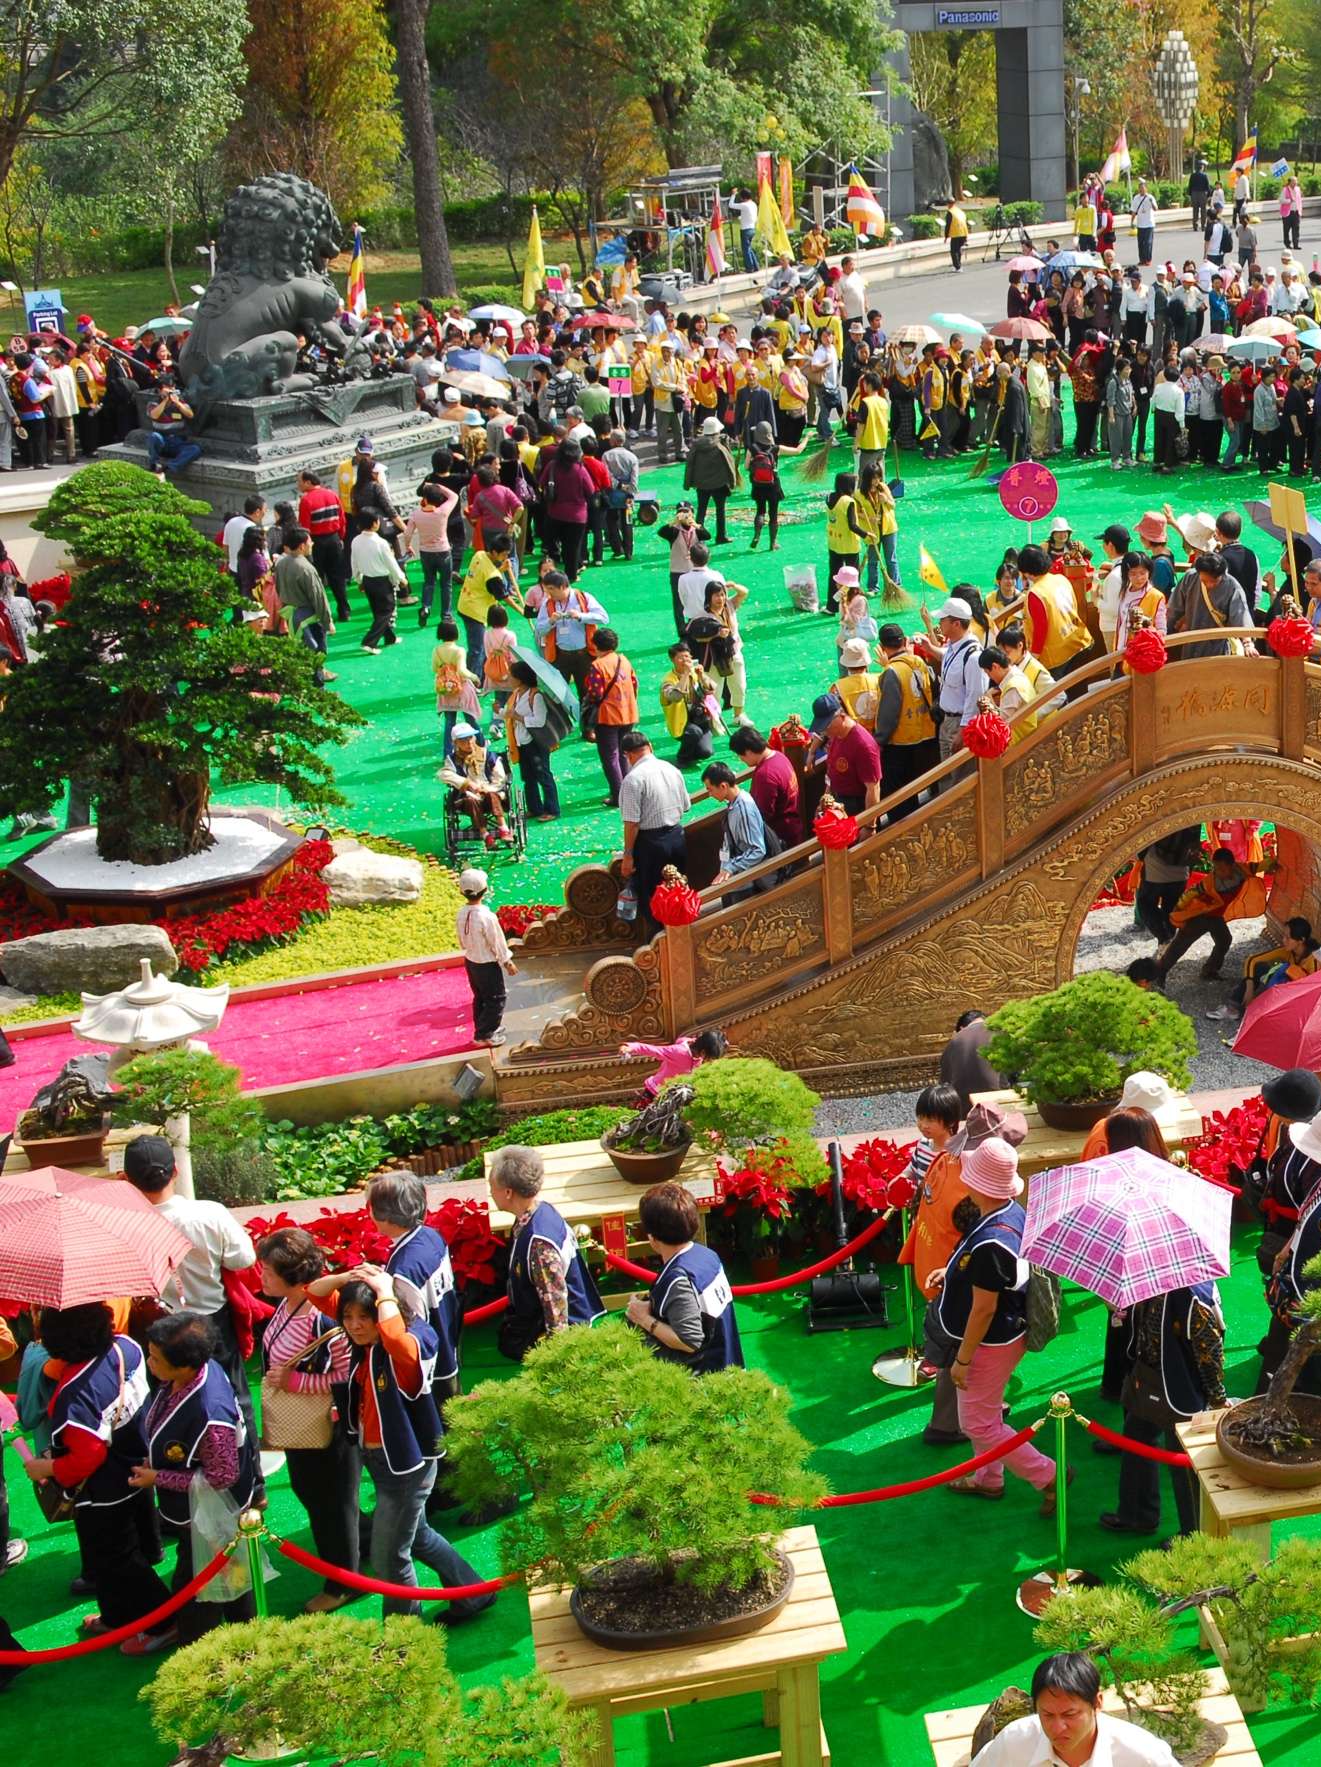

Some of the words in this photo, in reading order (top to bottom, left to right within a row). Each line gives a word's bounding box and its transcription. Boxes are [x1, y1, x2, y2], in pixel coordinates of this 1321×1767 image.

[939, 10, 999, 24] Panasonic
[617, 380, 623, 393] 7
[1024, 500, 1034, 513] 7
